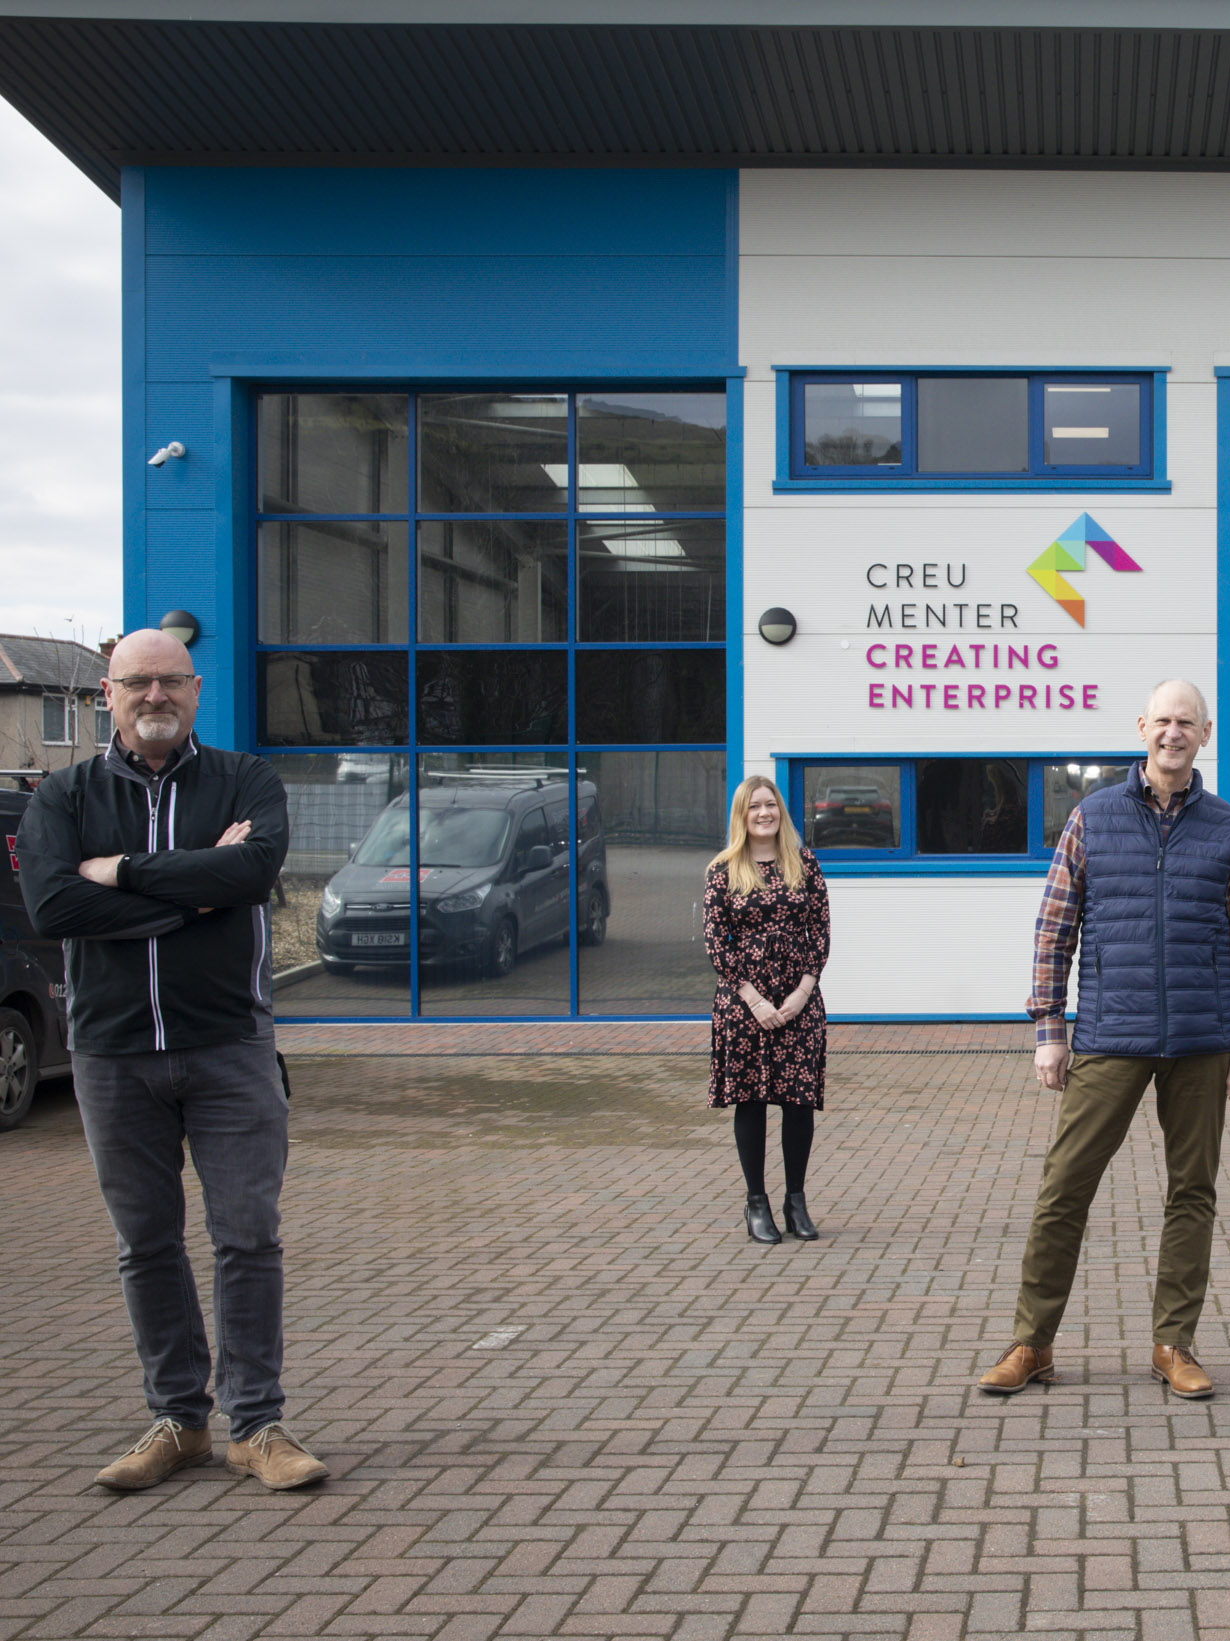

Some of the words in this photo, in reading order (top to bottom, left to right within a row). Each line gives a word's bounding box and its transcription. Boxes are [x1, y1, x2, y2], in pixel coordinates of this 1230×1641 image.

[866, 563, 967, 588] CREU
[866, 604, 1019, 629] MENTER
[866, 643, 1060, 670] CREATING
[869, 684, 1099, 710] ENTERPRISE
